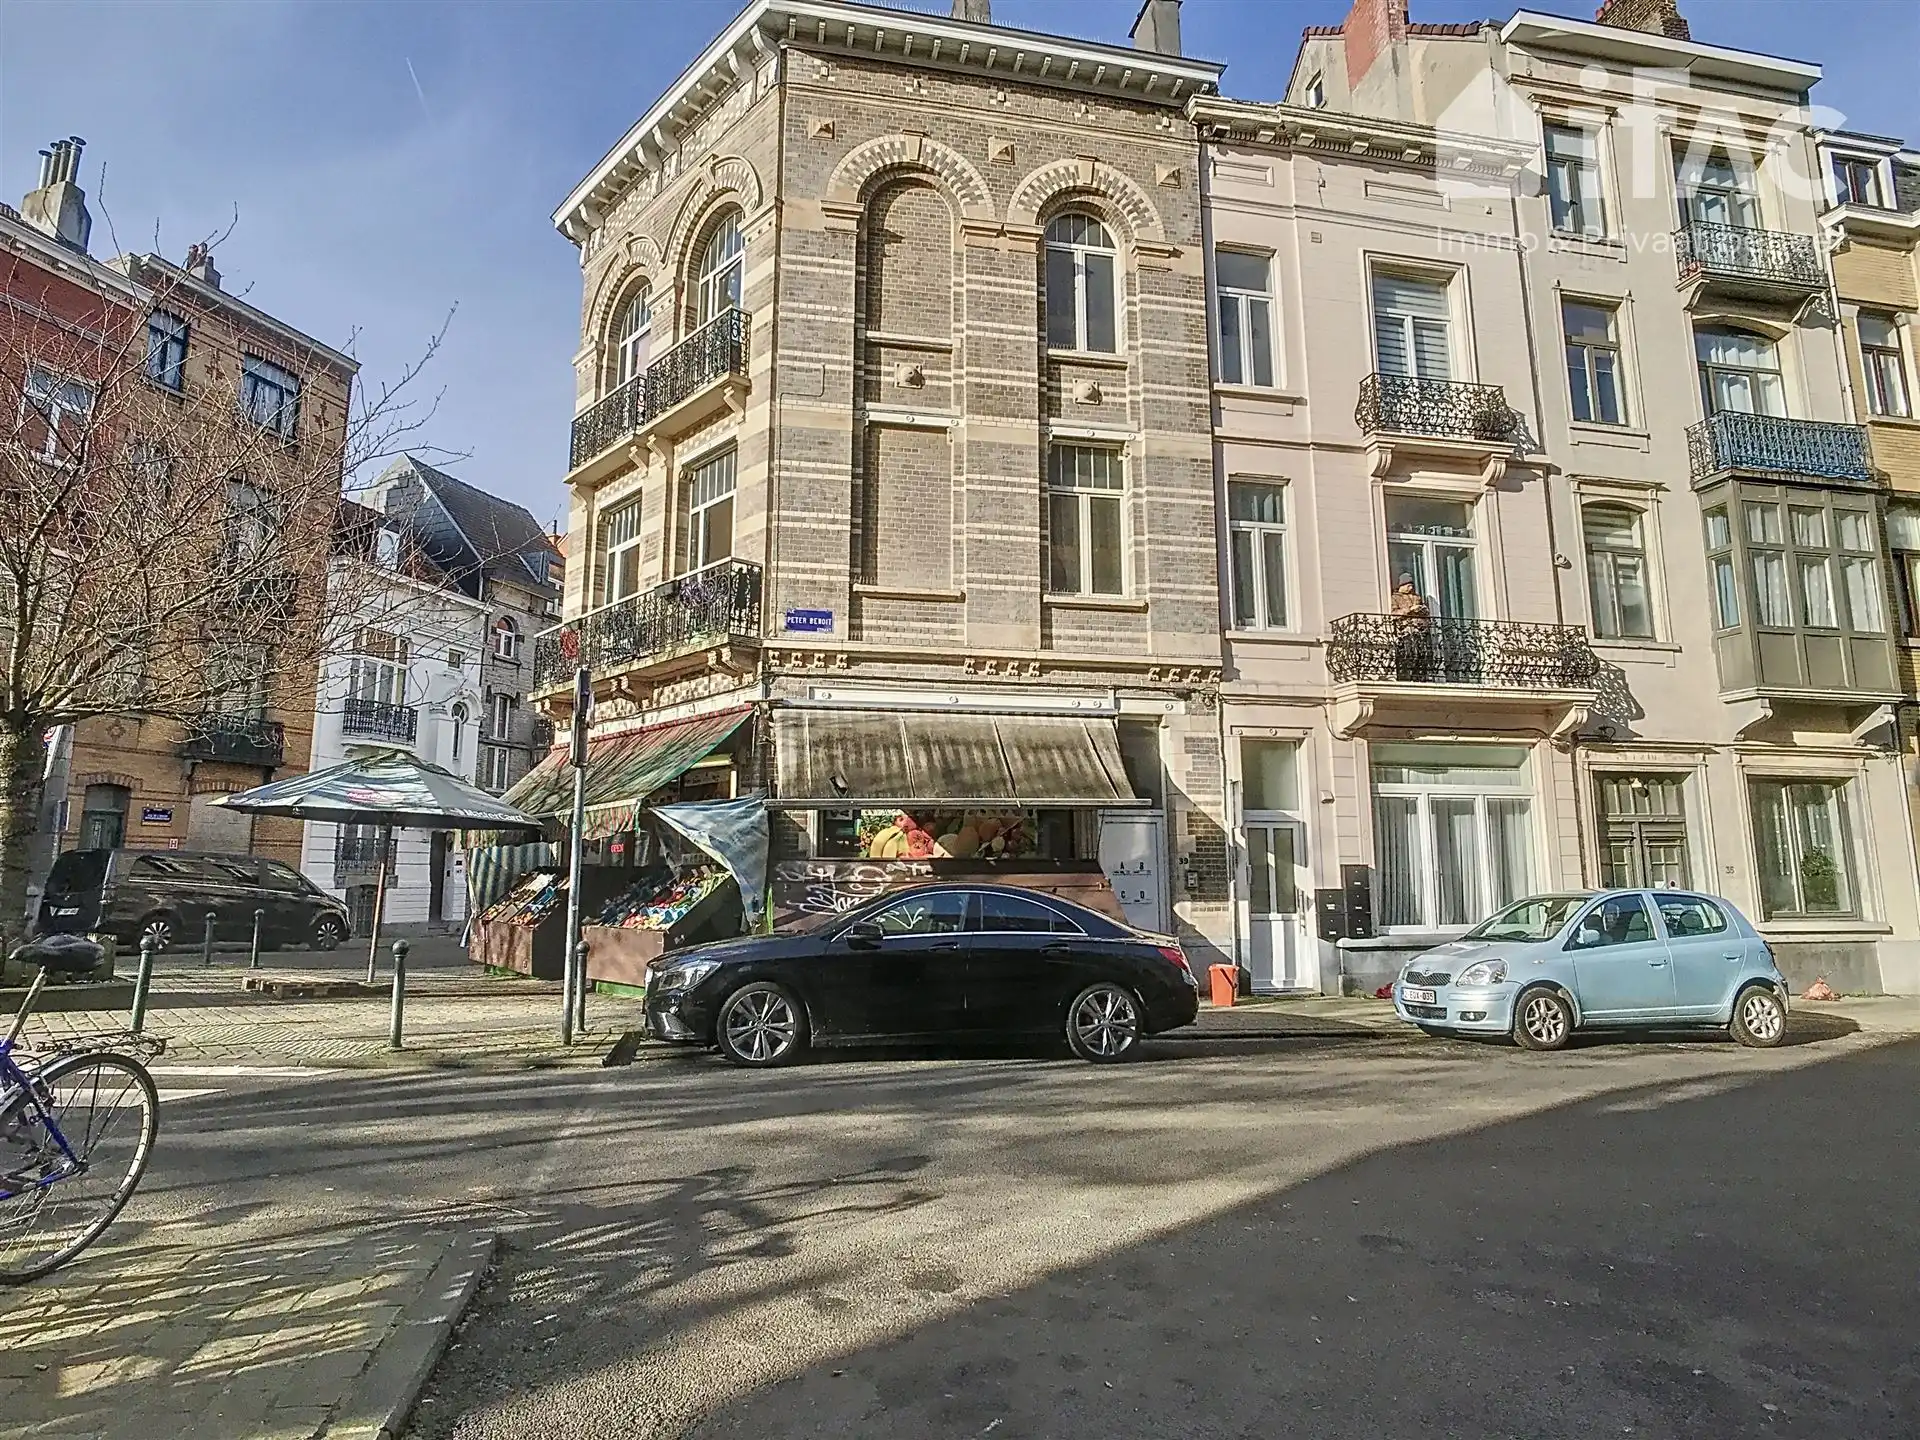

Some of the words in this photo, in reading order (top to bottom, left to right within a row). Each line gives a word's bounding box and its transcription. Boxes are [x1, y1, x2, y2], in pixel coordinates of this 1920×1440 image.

[787, 616, 807, 624] PETER
[809, 617, 832, 626] BENOIT
[1120, 861, 1125, 869] A
[1726, 866, 1735, 874] 35
